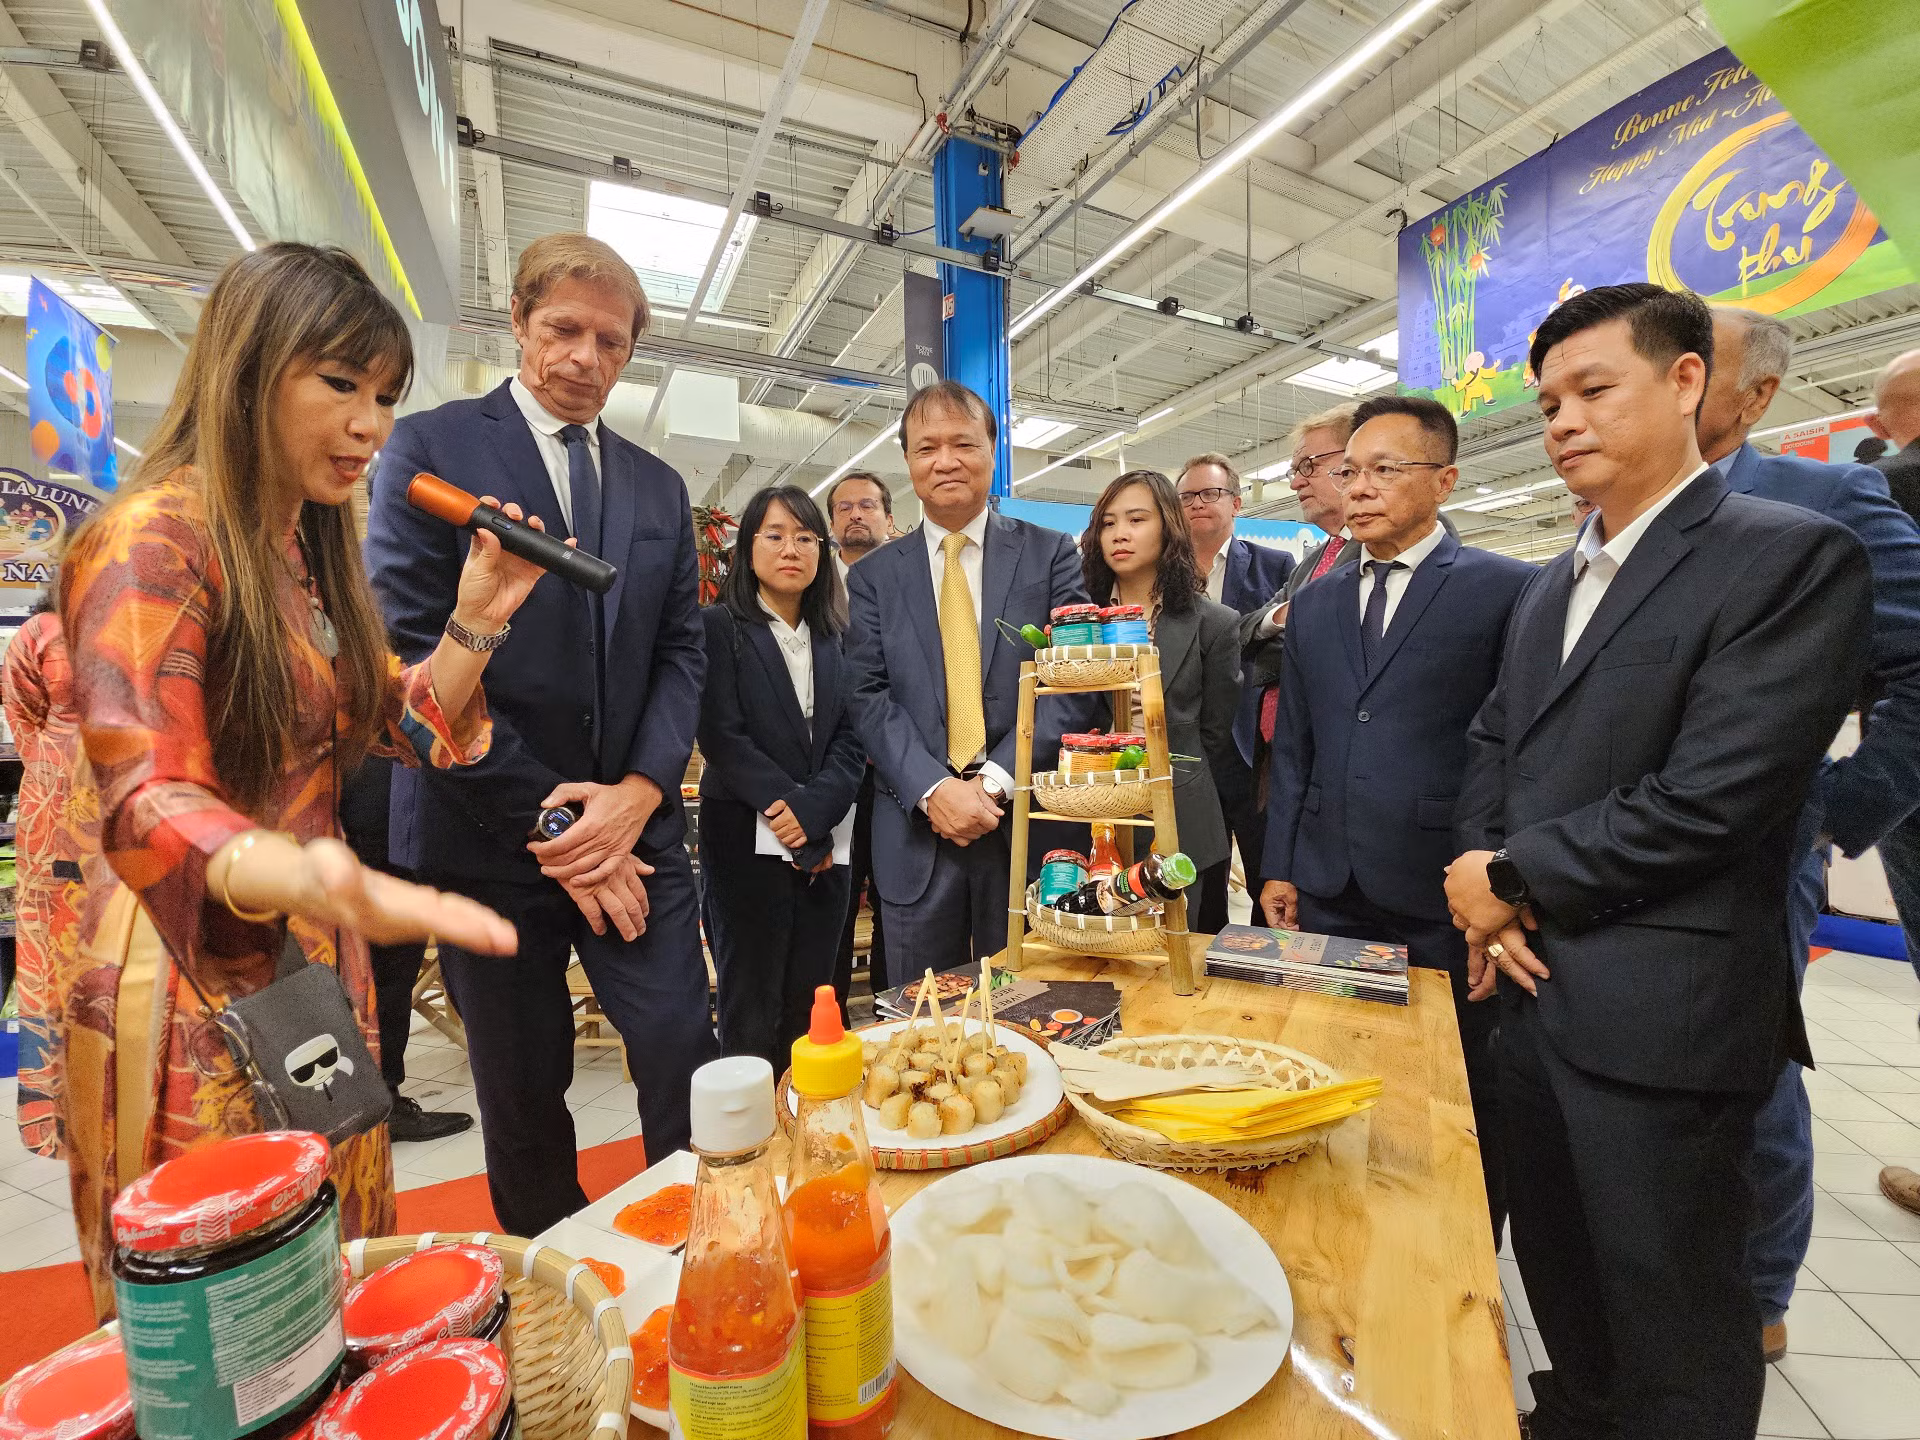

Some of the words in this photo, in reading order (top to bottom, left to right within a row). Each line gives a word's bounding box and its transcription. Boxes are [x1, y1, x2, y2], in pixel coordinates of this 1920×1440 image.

[1612, 94, 1696, 150] Bonne
[1579, 144, 1658, 195] Happy
[1794, 426, 1824, 438] SAISIR
[2, 480, 30, 496] LA
[997, 992, 1026, 1007] LIVRE
[368, 1335, 425, 1368] Cholimex
